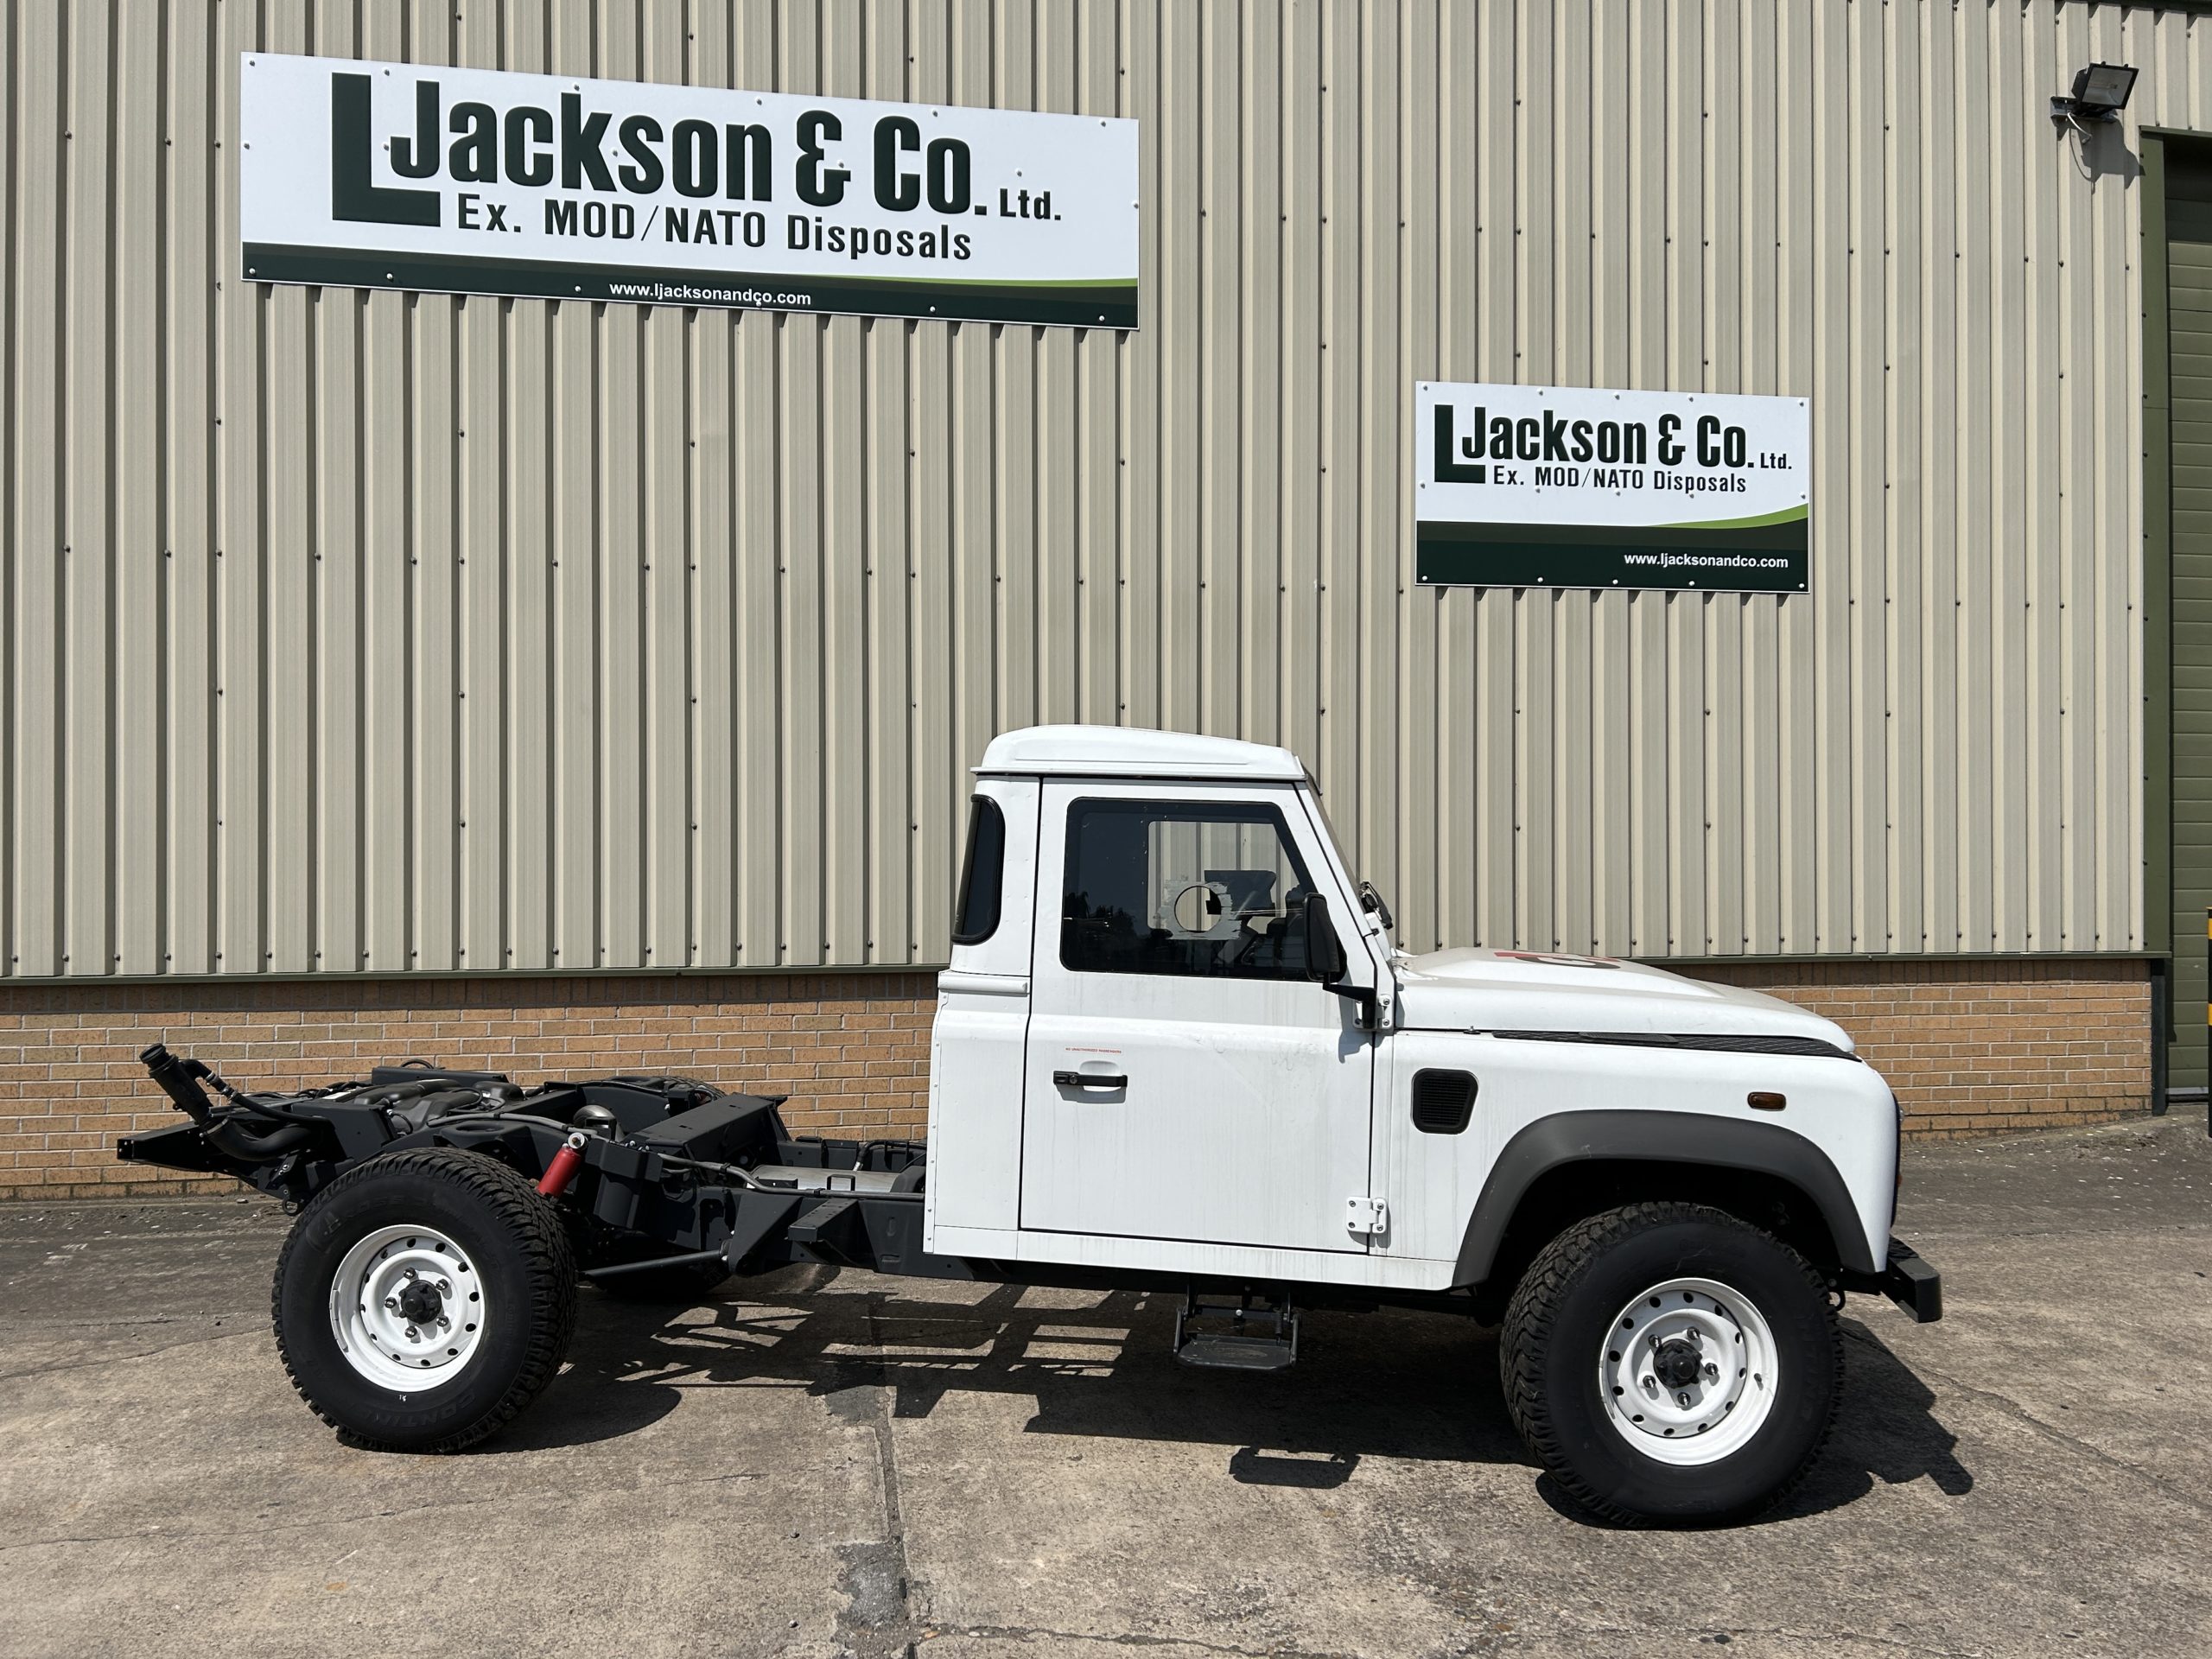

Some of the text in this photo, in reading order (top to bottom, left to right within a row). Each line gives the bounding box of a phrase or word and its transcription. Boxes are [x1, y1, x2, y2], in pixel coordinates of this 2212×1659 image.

[796, 110, 851, 207] &
[874, 116, 988, 216] Co.
[1000, 188, 1062, 221] Ltd.
[458, 193, 971, 260] Ex. MOD/NATO Disposals
[609, 283, 811, 306] www.ljacksonandco.com
[1658, 413, 1686, 467] &
[1696, 415, 1755, 468] Co.
[1760, 452, 1793, 469] Ltd.
[1493, 465, 1746, 493] Ex. MOD/NATO Disposals
[1624, 552, 1789, 569] www.ljacksonandco.com
